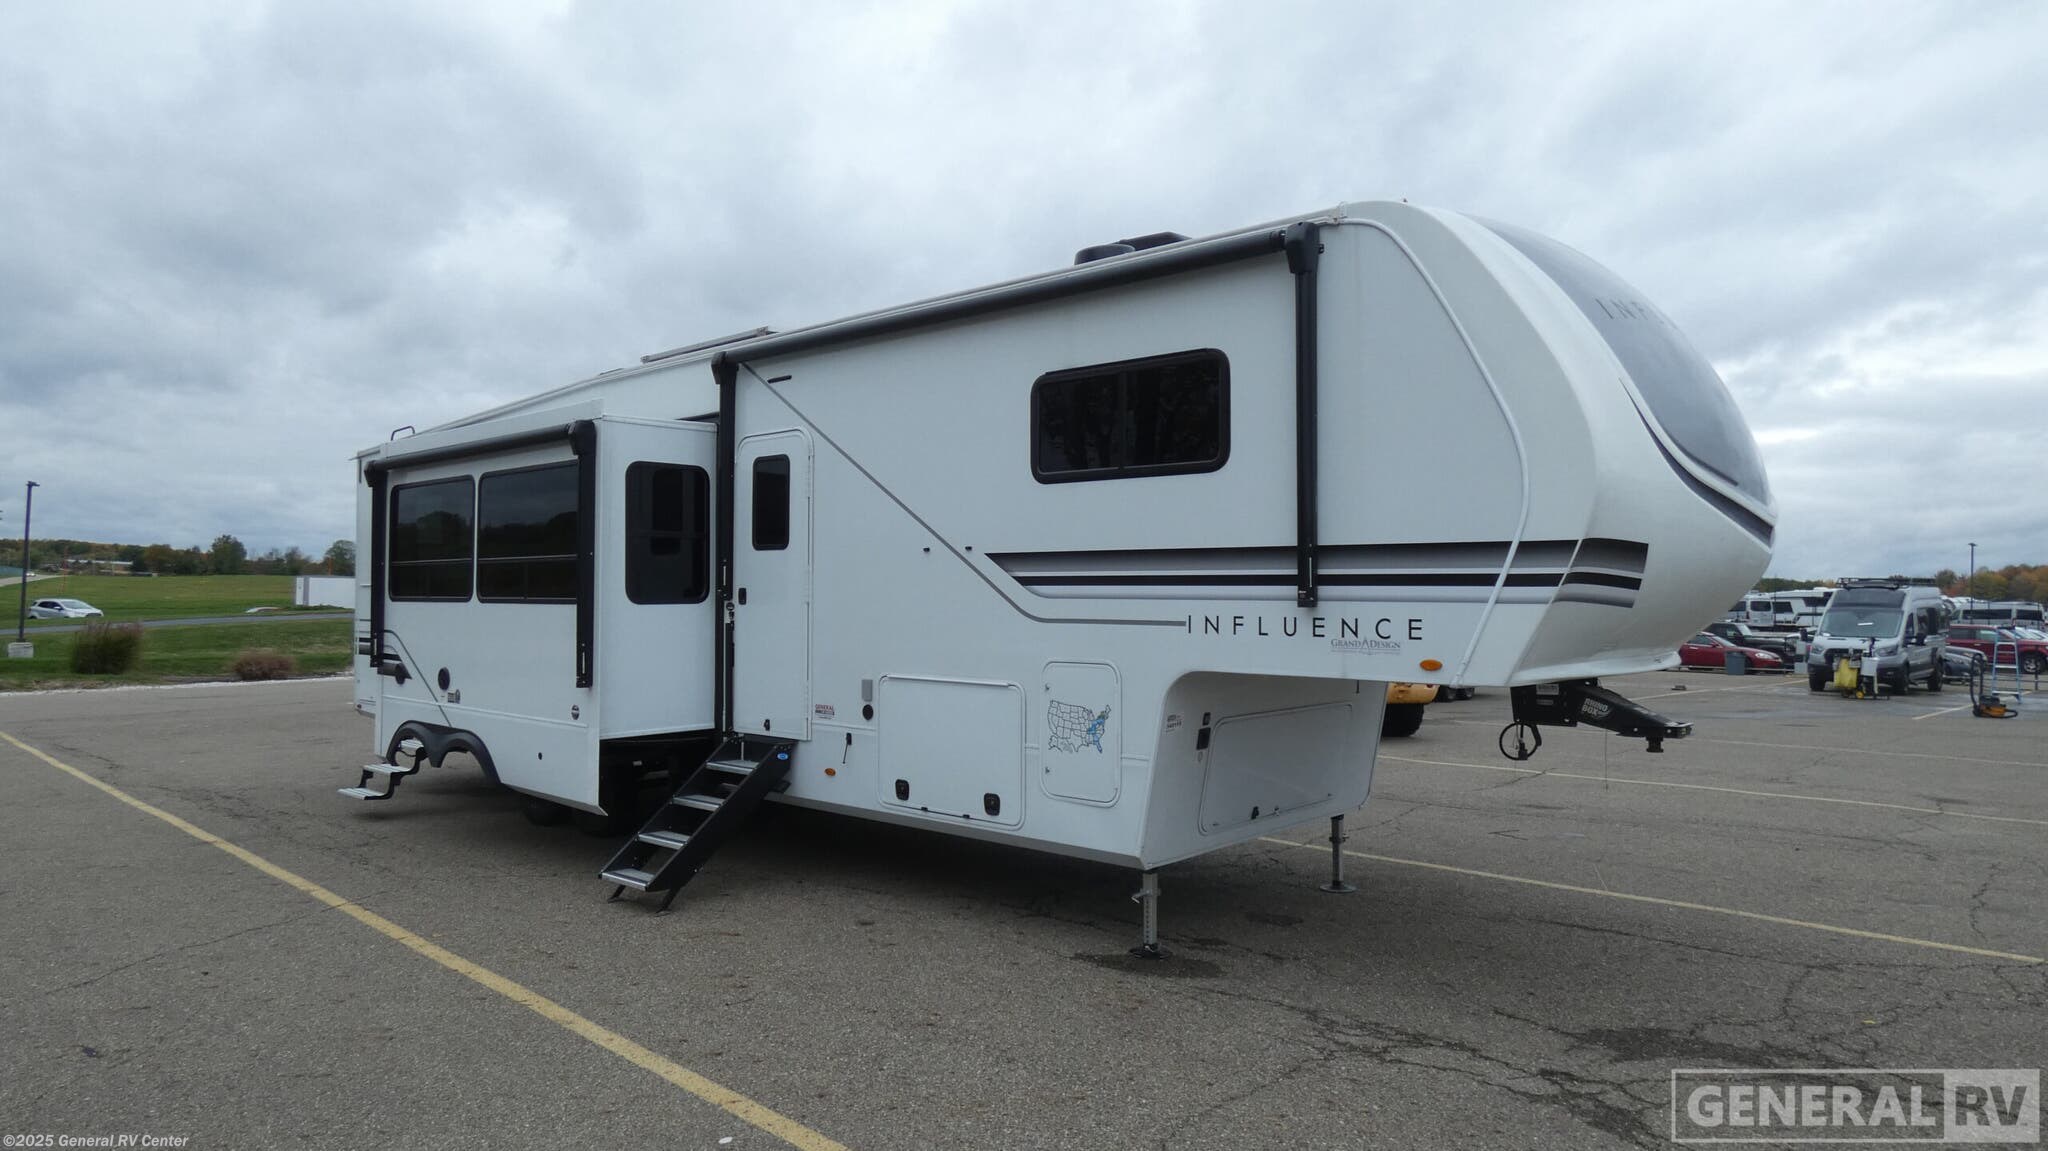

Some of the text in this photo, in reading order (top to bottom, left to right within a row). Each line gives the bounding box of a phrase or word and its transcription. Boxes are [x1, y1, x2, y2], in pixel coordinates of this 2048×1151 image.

[1187, 615, 1423, 640] INFLUENCE
[1581, 704, 1599, 717] BOX
[1584, 698, 1608, 712] RHINO
